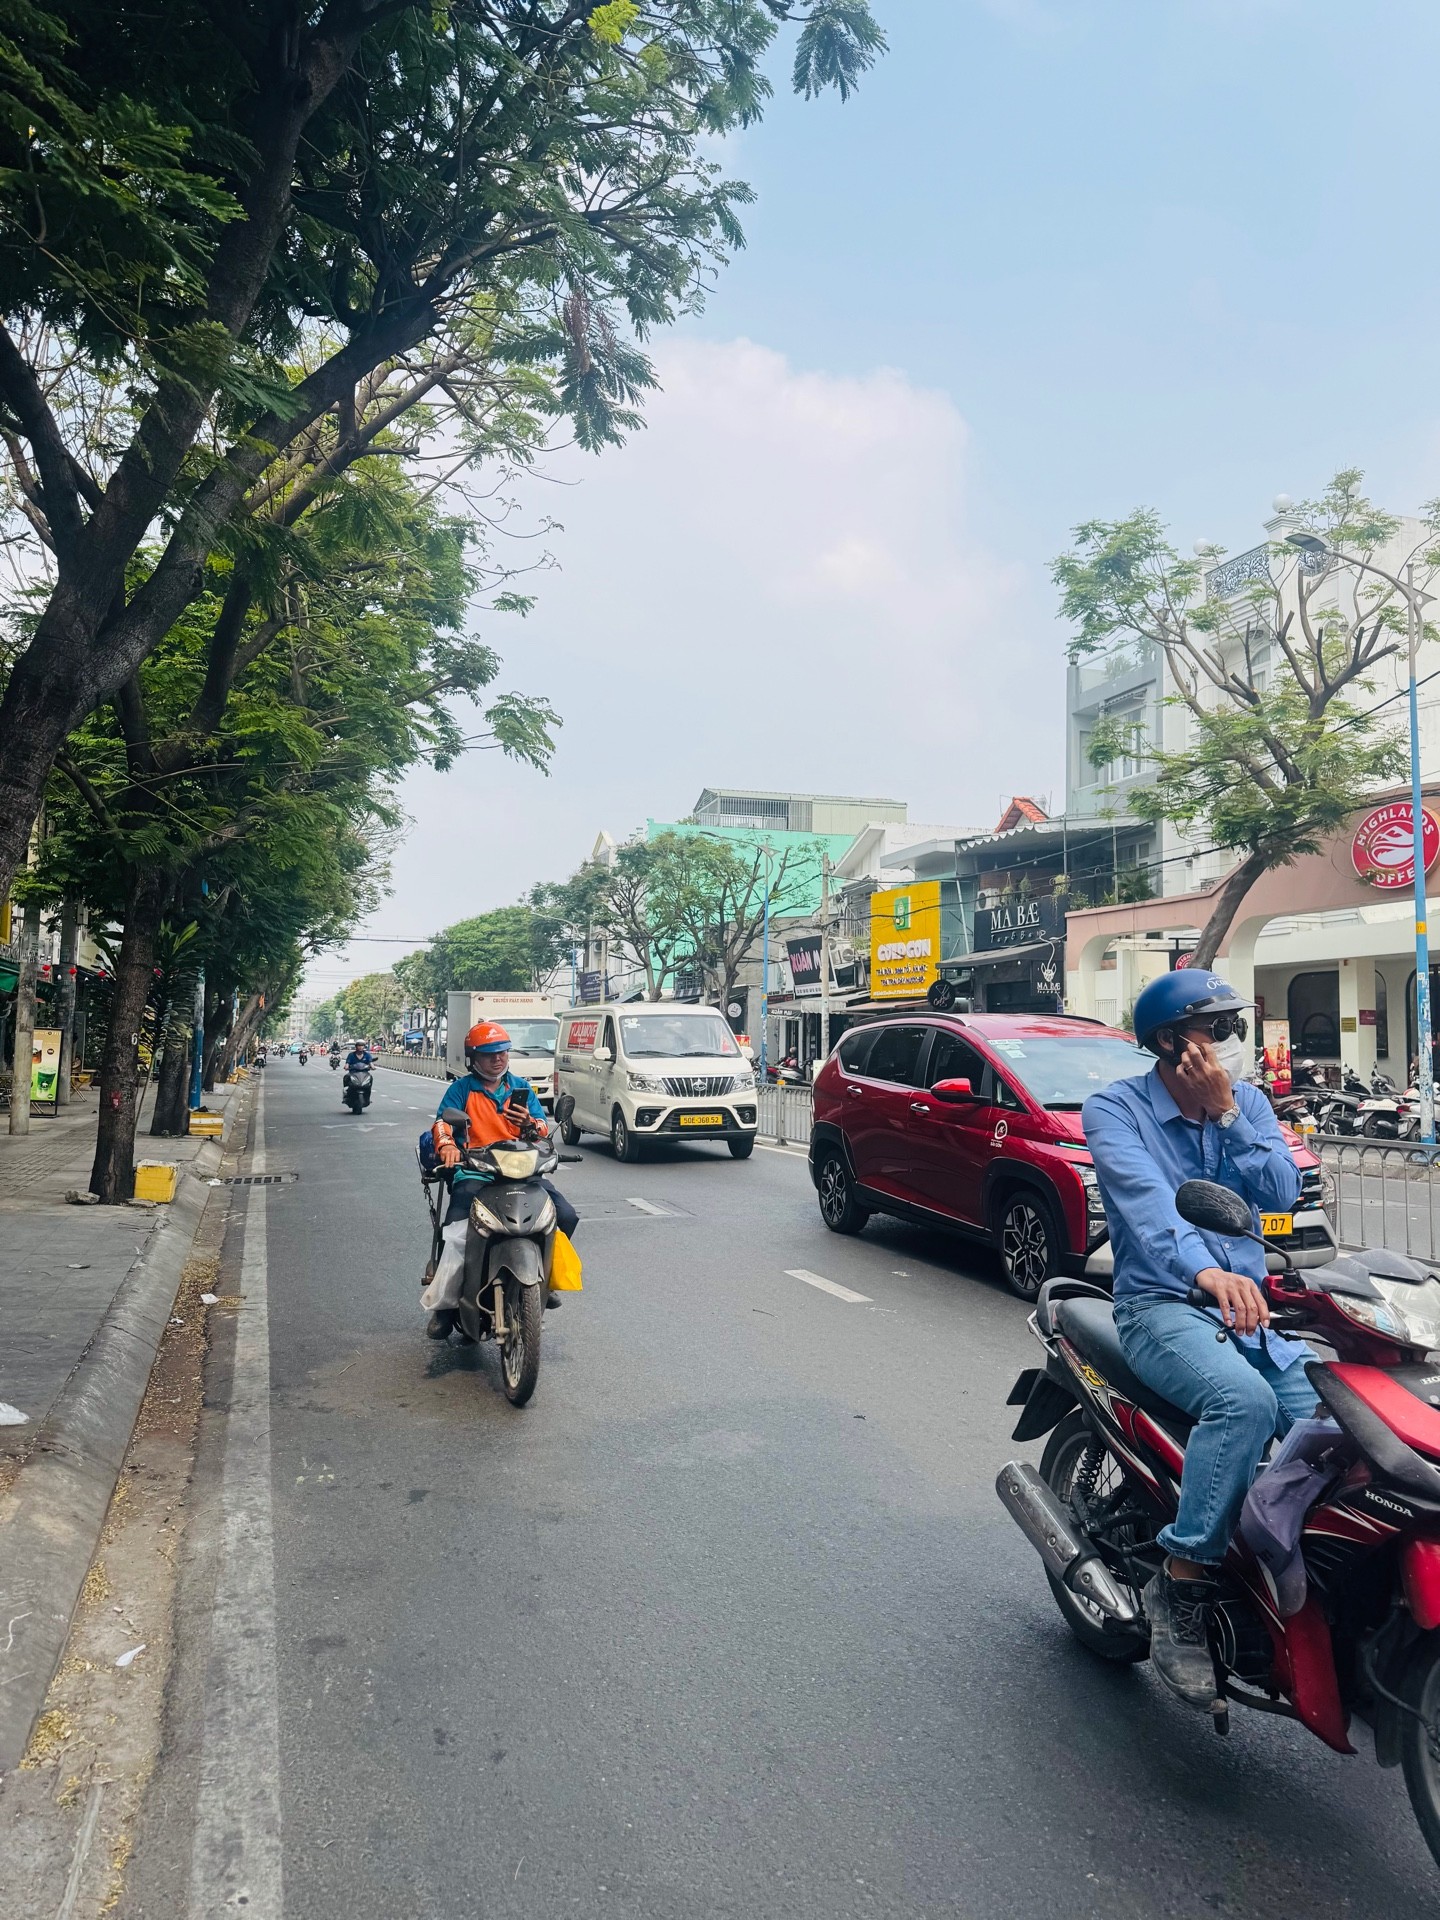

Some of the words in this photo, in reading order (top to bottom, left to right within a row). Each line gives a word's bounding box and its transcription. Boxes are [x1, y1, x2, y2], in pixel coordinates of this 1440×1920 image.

[1357, 807, 1434, 846] HIGHLADS
[991, 908, 1012, 930] MA
[131, 1032, 138, 1046] 6
[1364, 1489, 1415, 1518] HONDA
